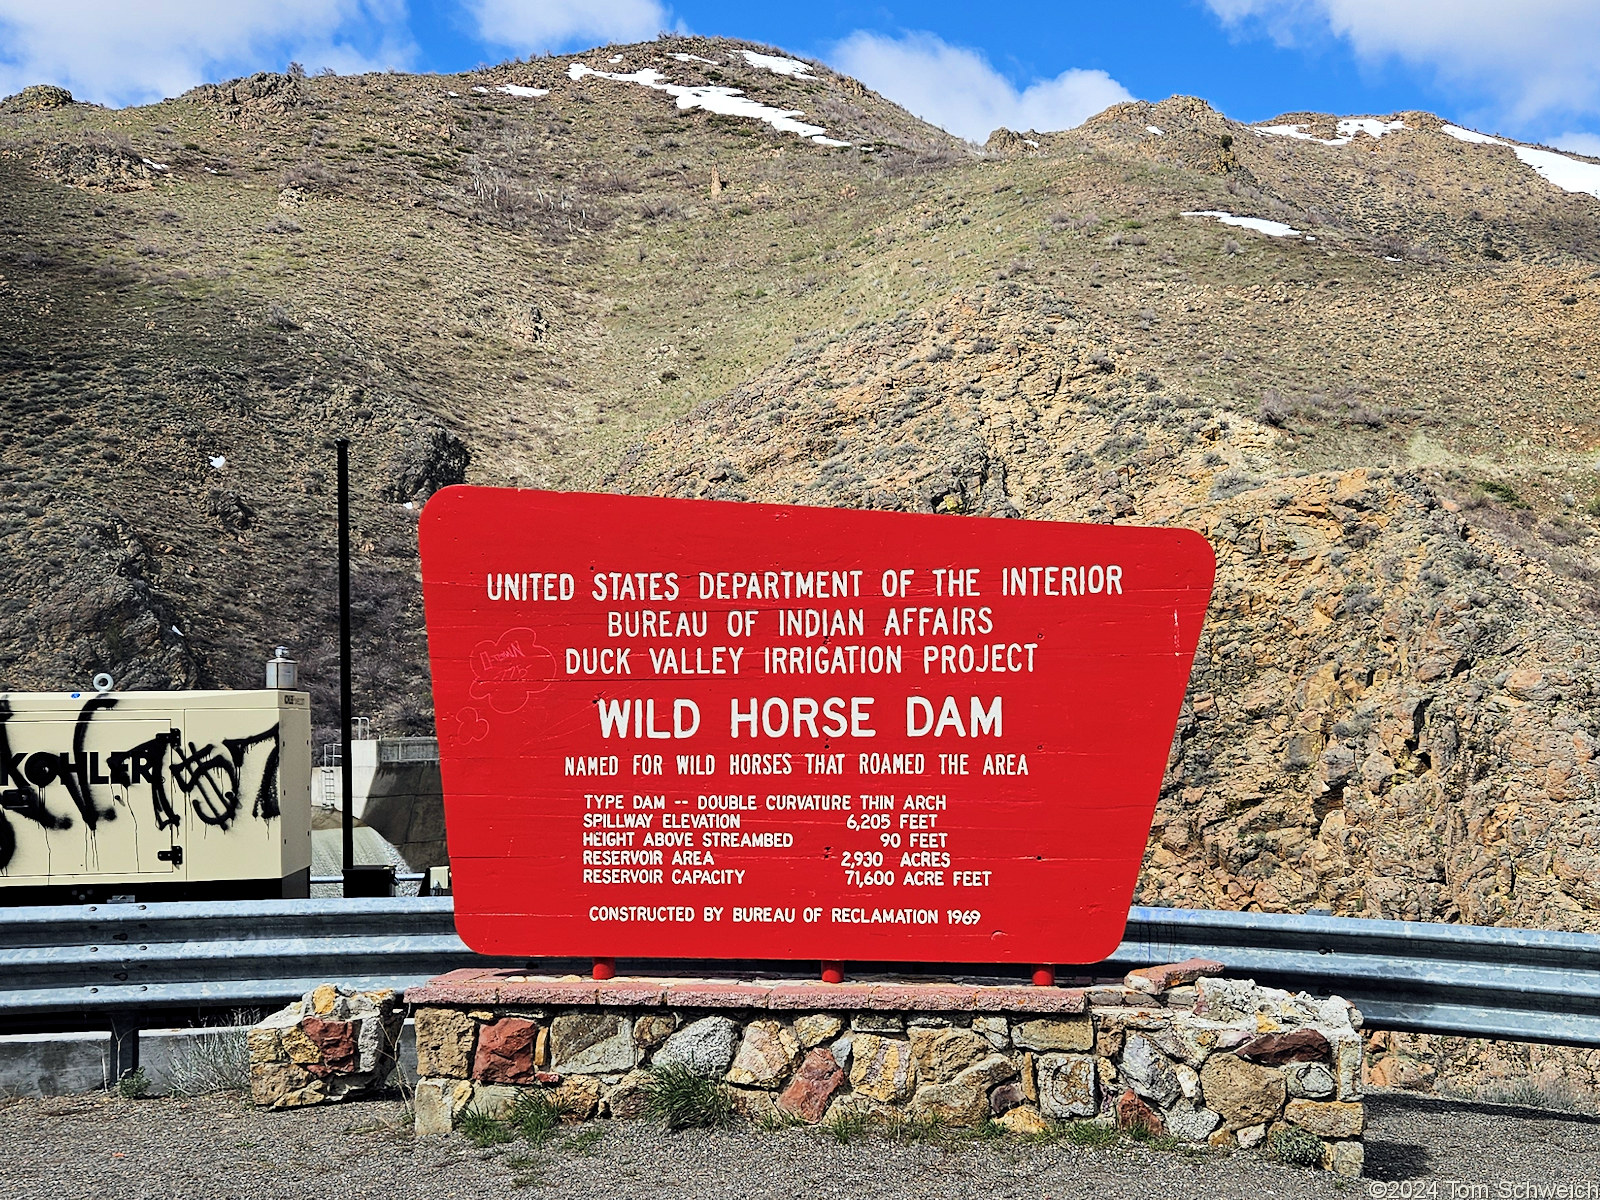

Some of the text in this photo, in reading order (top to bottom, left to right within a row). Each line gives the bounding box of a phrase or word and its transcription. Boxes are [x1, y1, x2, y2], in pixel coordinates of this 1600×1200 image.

[487, 565, 1122, 601] UNITED STATES DEPARTMENT OF THE INTERIOR
[608, 607, 992, 638] BUREAU OF INDIAN AFFAIRS
[565, 643, 1038, 674] DUCK VALLEY IRRIGATION PROJECT
[596, 696, 1002, 738] WILD HORSE DAM
[0, 752, 153, 786] KOHLER
[564, 753, 1028, 776] NAMED FOR WILD HORSES THAT ROAMED THE AREA
[583, 795, 624, 809] TYPE
[632, 795, 665, 809] DAM
[696, 795, 756, 810] DOUBLE
[764, 795, 851, 810] CURVATURE
[859, 795, 894, 810] THIN
[902, 795, 946, 810] ARCH
[582, 813, 937, 831] SPILLWAY ELEVATION 6,205 FEET
[582, 832, 948, 848] HEIGHT ABOVE STREAMBED 90 FEET
[582, 850, 950, 868] RESERVOIR AREA 2,930 ACRES
[582, 869, 992, 888] RESERVOIR CAPACITY 71,600 ACRE FEET
[588, 906, 981, 925] CONSTRUCTED BY BUREAU OF RECLAMATION 1969
